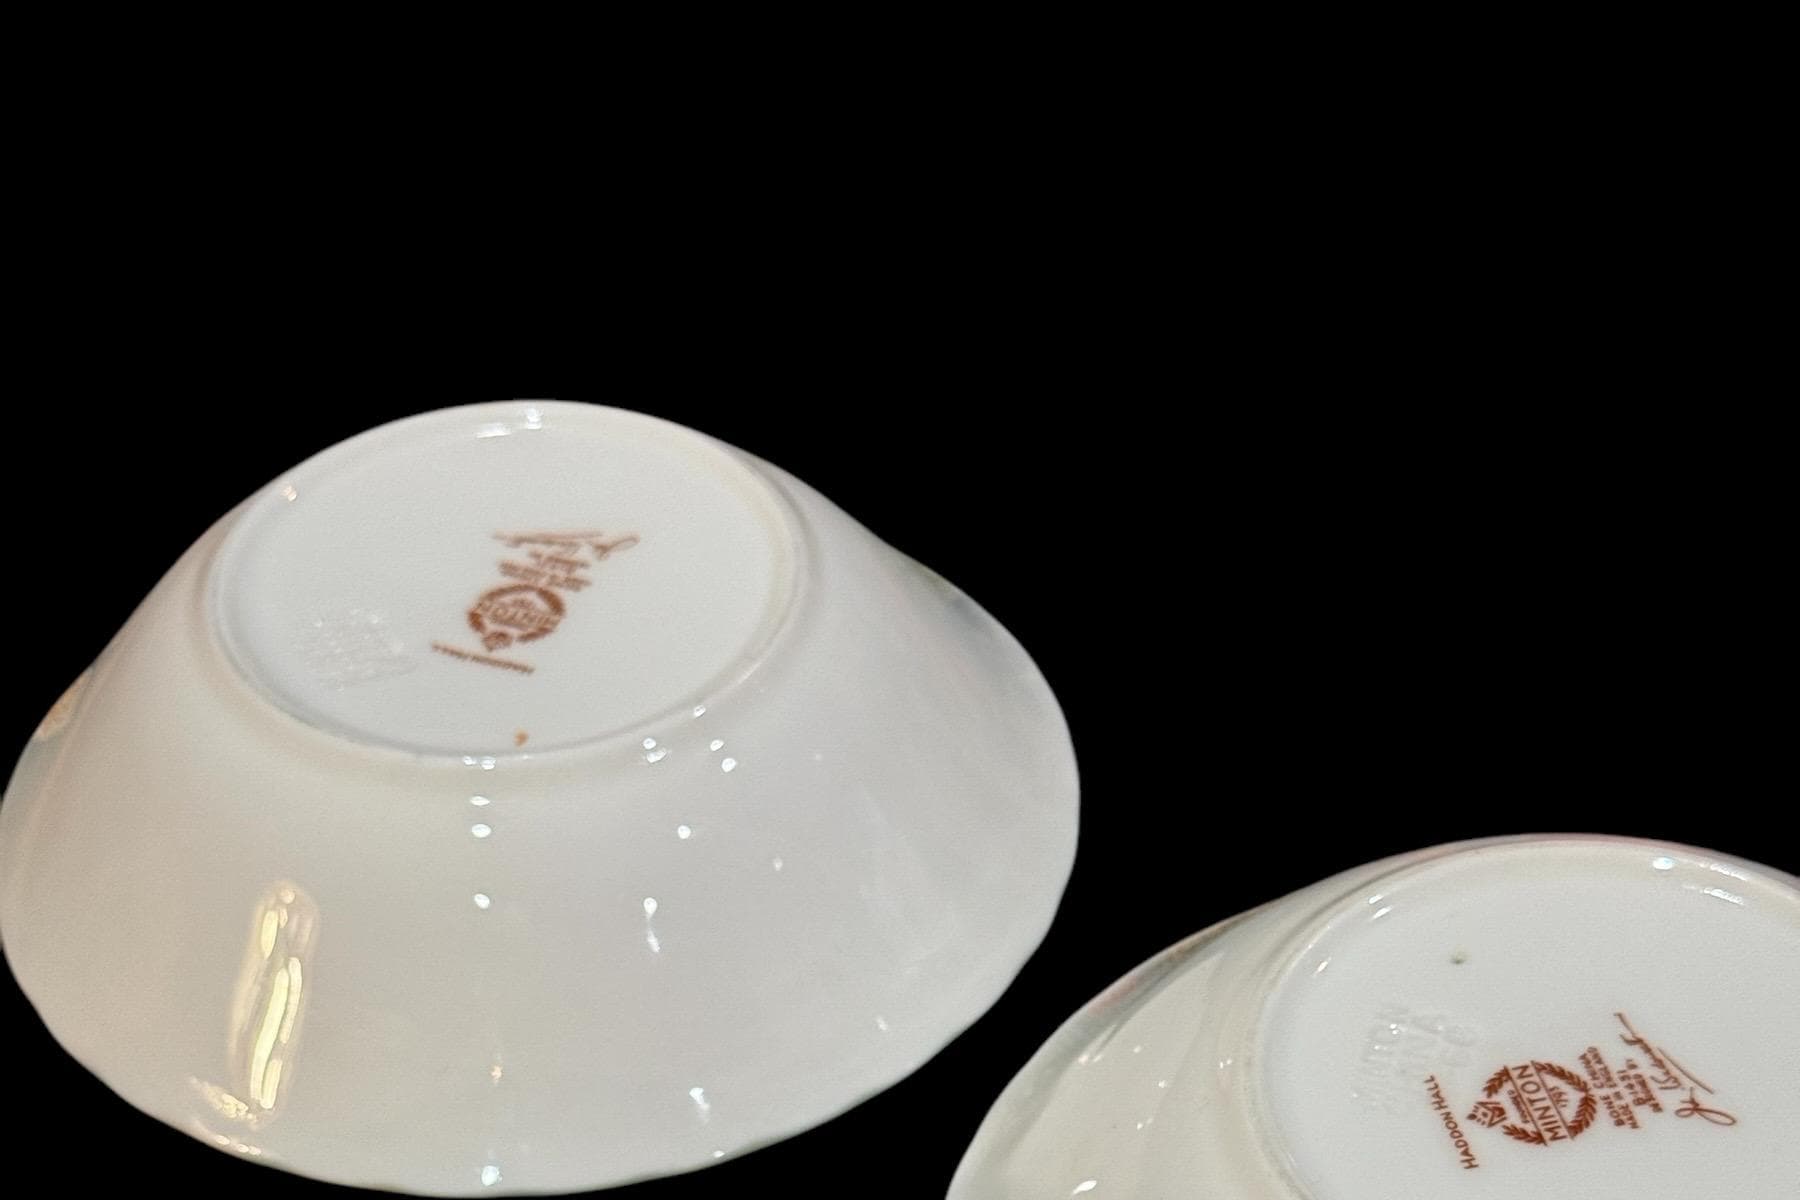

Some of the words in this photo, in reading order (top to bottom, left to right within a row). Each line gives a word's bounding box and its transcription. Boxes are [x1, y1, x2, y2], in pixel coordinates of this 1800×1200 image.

[1579, 1052, 1604, 1089] CHINA
[1423, 1075, 1448, 1111] HALL
[1512, 1064, 1567, 1142] MINTON
[1600, 1095, 1626, 1127] BONE
[1440, 1111, 1479, 1170] HADDON
